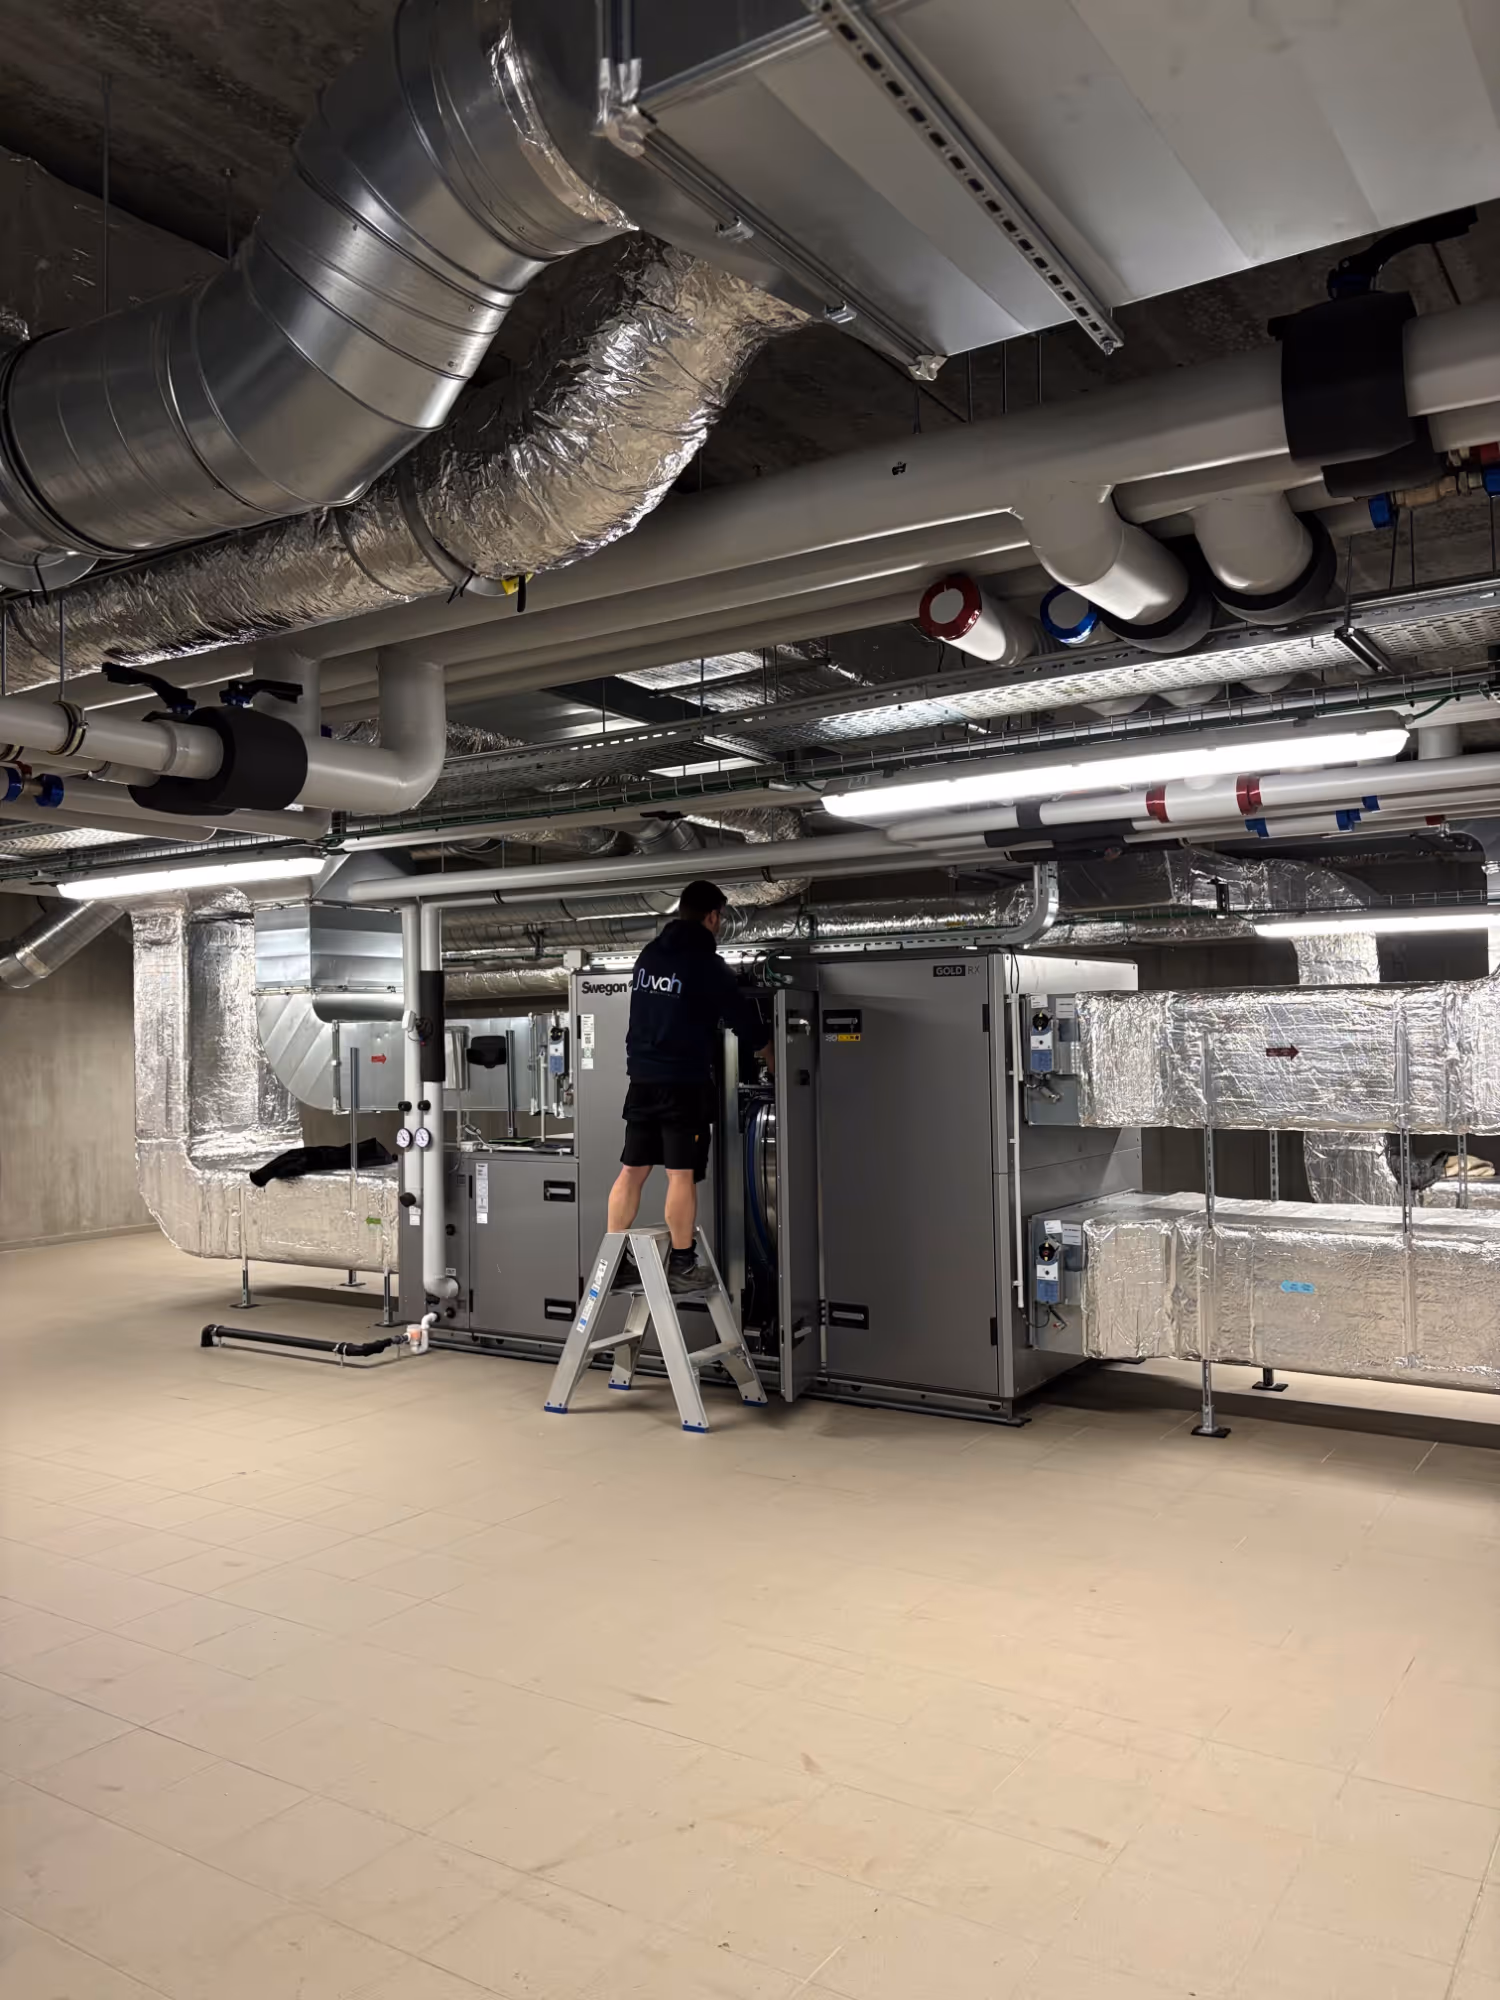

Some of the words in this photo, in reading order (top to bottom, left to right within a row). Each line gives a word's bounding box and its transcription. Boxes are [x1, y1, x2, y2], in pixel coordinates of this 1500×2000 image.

[935, 966, 963, 976] GOLD
[967, 965, 980, 975] RX
[581, 981, 628, 996] Swegon
